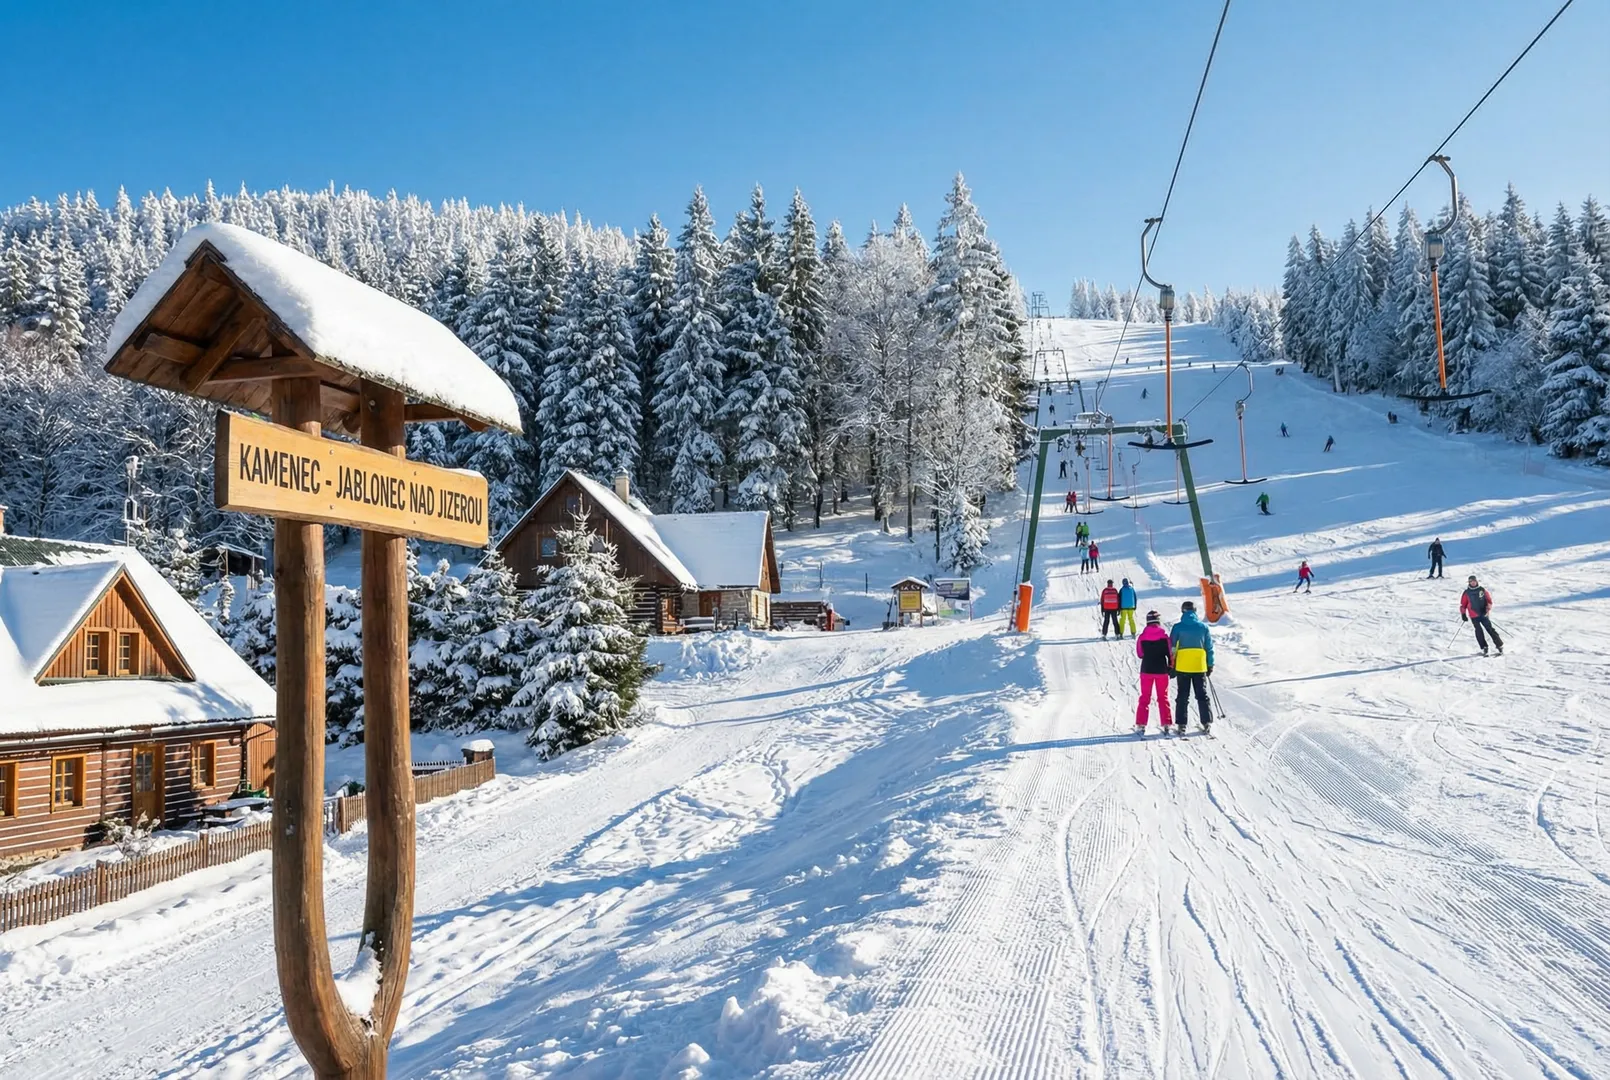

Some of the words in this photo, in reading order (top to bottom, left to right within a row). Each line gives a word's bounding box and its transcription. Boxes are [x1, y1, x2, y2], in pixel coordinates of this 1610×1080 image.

[239, 442, 321, 495] KAMENEC
[335, 465, 406, 511] JABLONEC
[409, 482, 435, 516] NAD
[437, 488, 483, 526] JIZEROU
